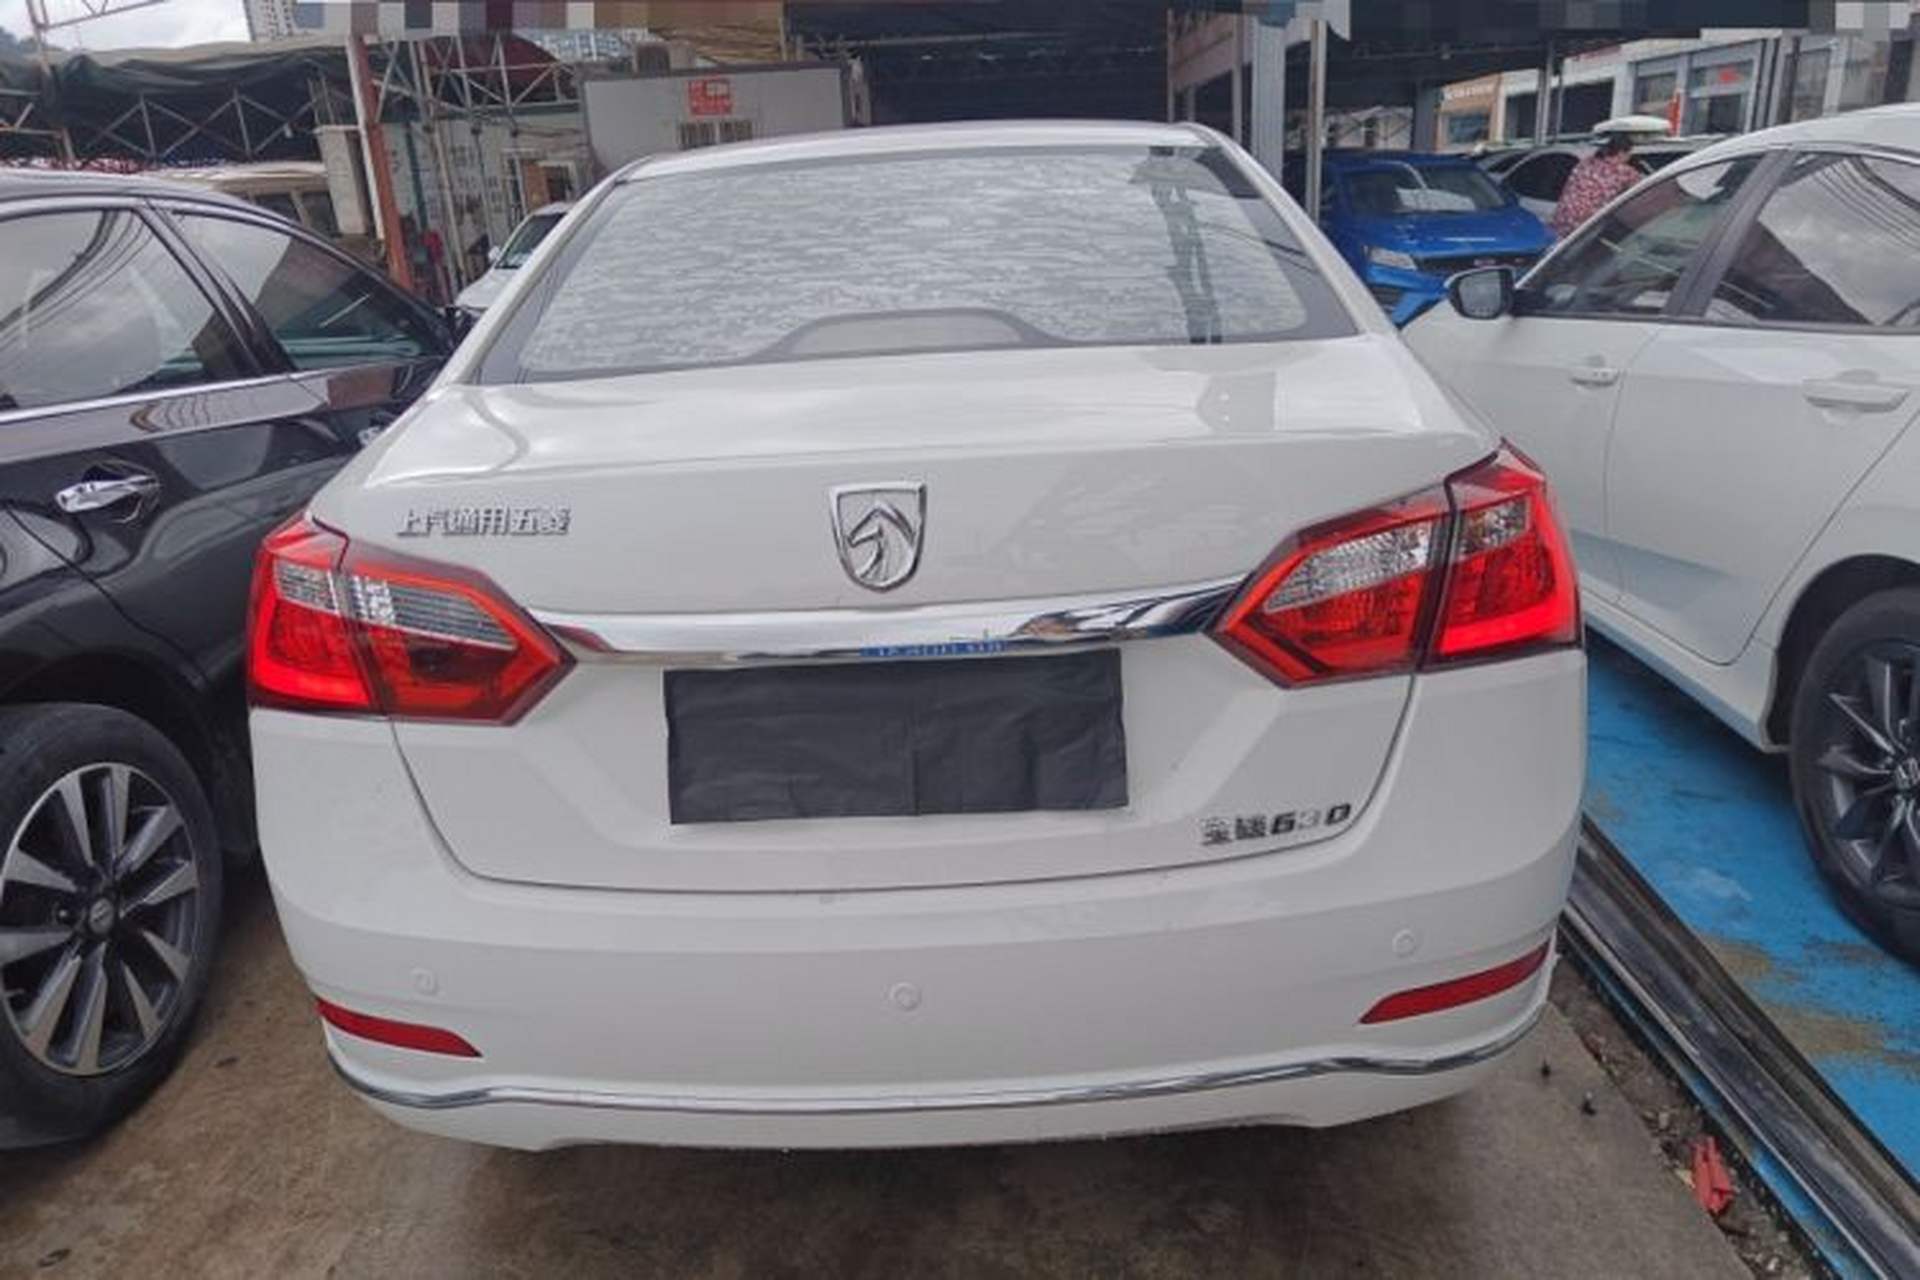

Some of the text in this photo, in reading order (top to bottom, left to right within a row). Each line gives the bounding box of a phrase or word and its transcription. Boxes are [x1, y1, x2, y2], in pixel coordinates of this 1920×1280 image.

[395, 507, 571, 537] 上汽通用五菱
